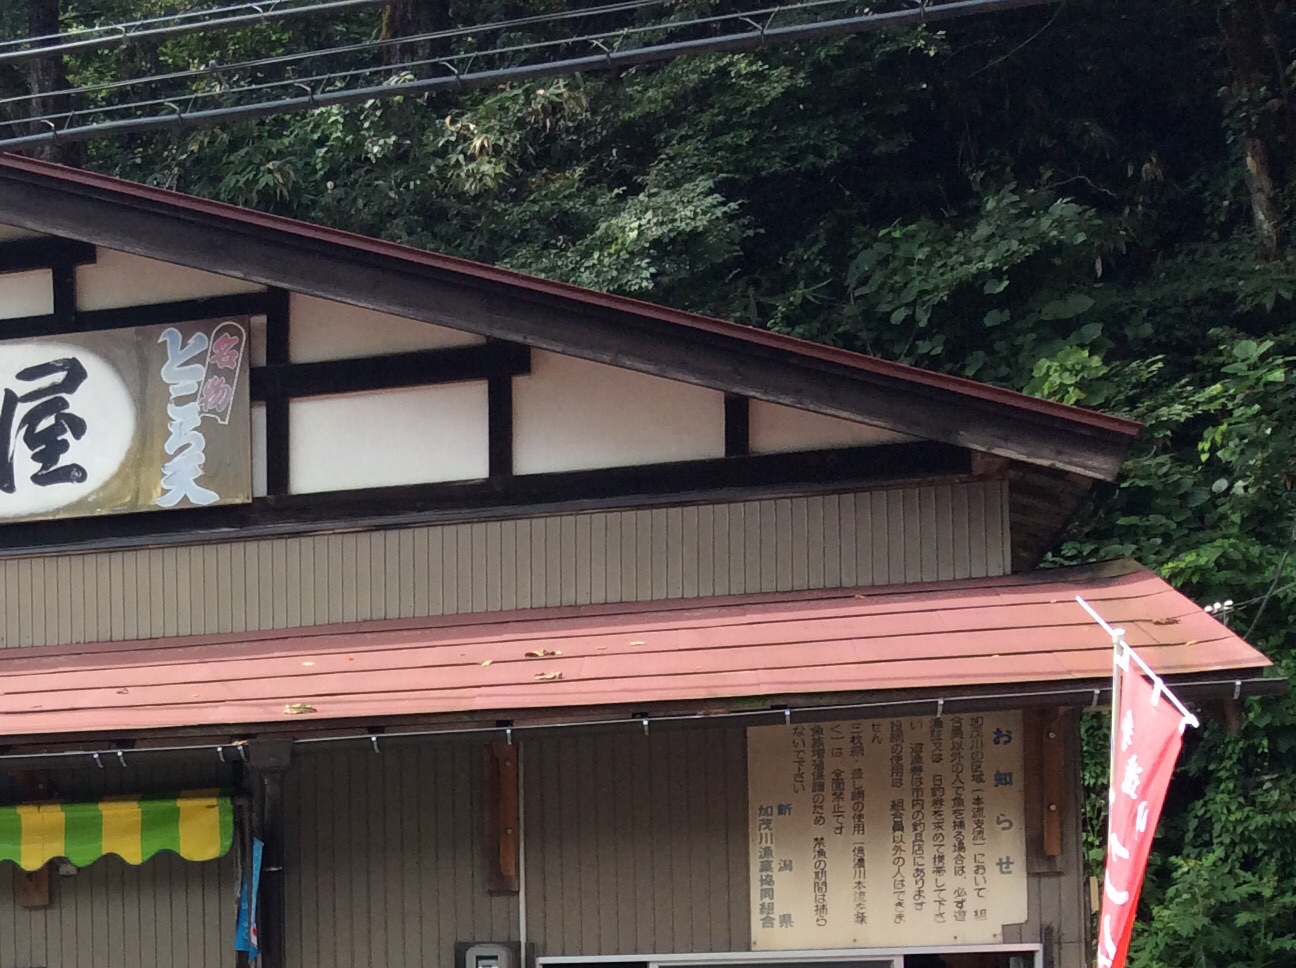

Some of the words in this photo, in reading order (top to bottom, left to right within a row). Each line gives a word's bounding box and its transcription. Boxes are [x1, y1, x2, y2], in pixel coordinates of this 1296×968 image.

[207, 333, 239, 411] 名物
[992, 727, 1015, 875] お知らせ
[758, 803, 775, 930] 加茂川漁業協同組合
[777, 803, 795, 929] 新潟県
